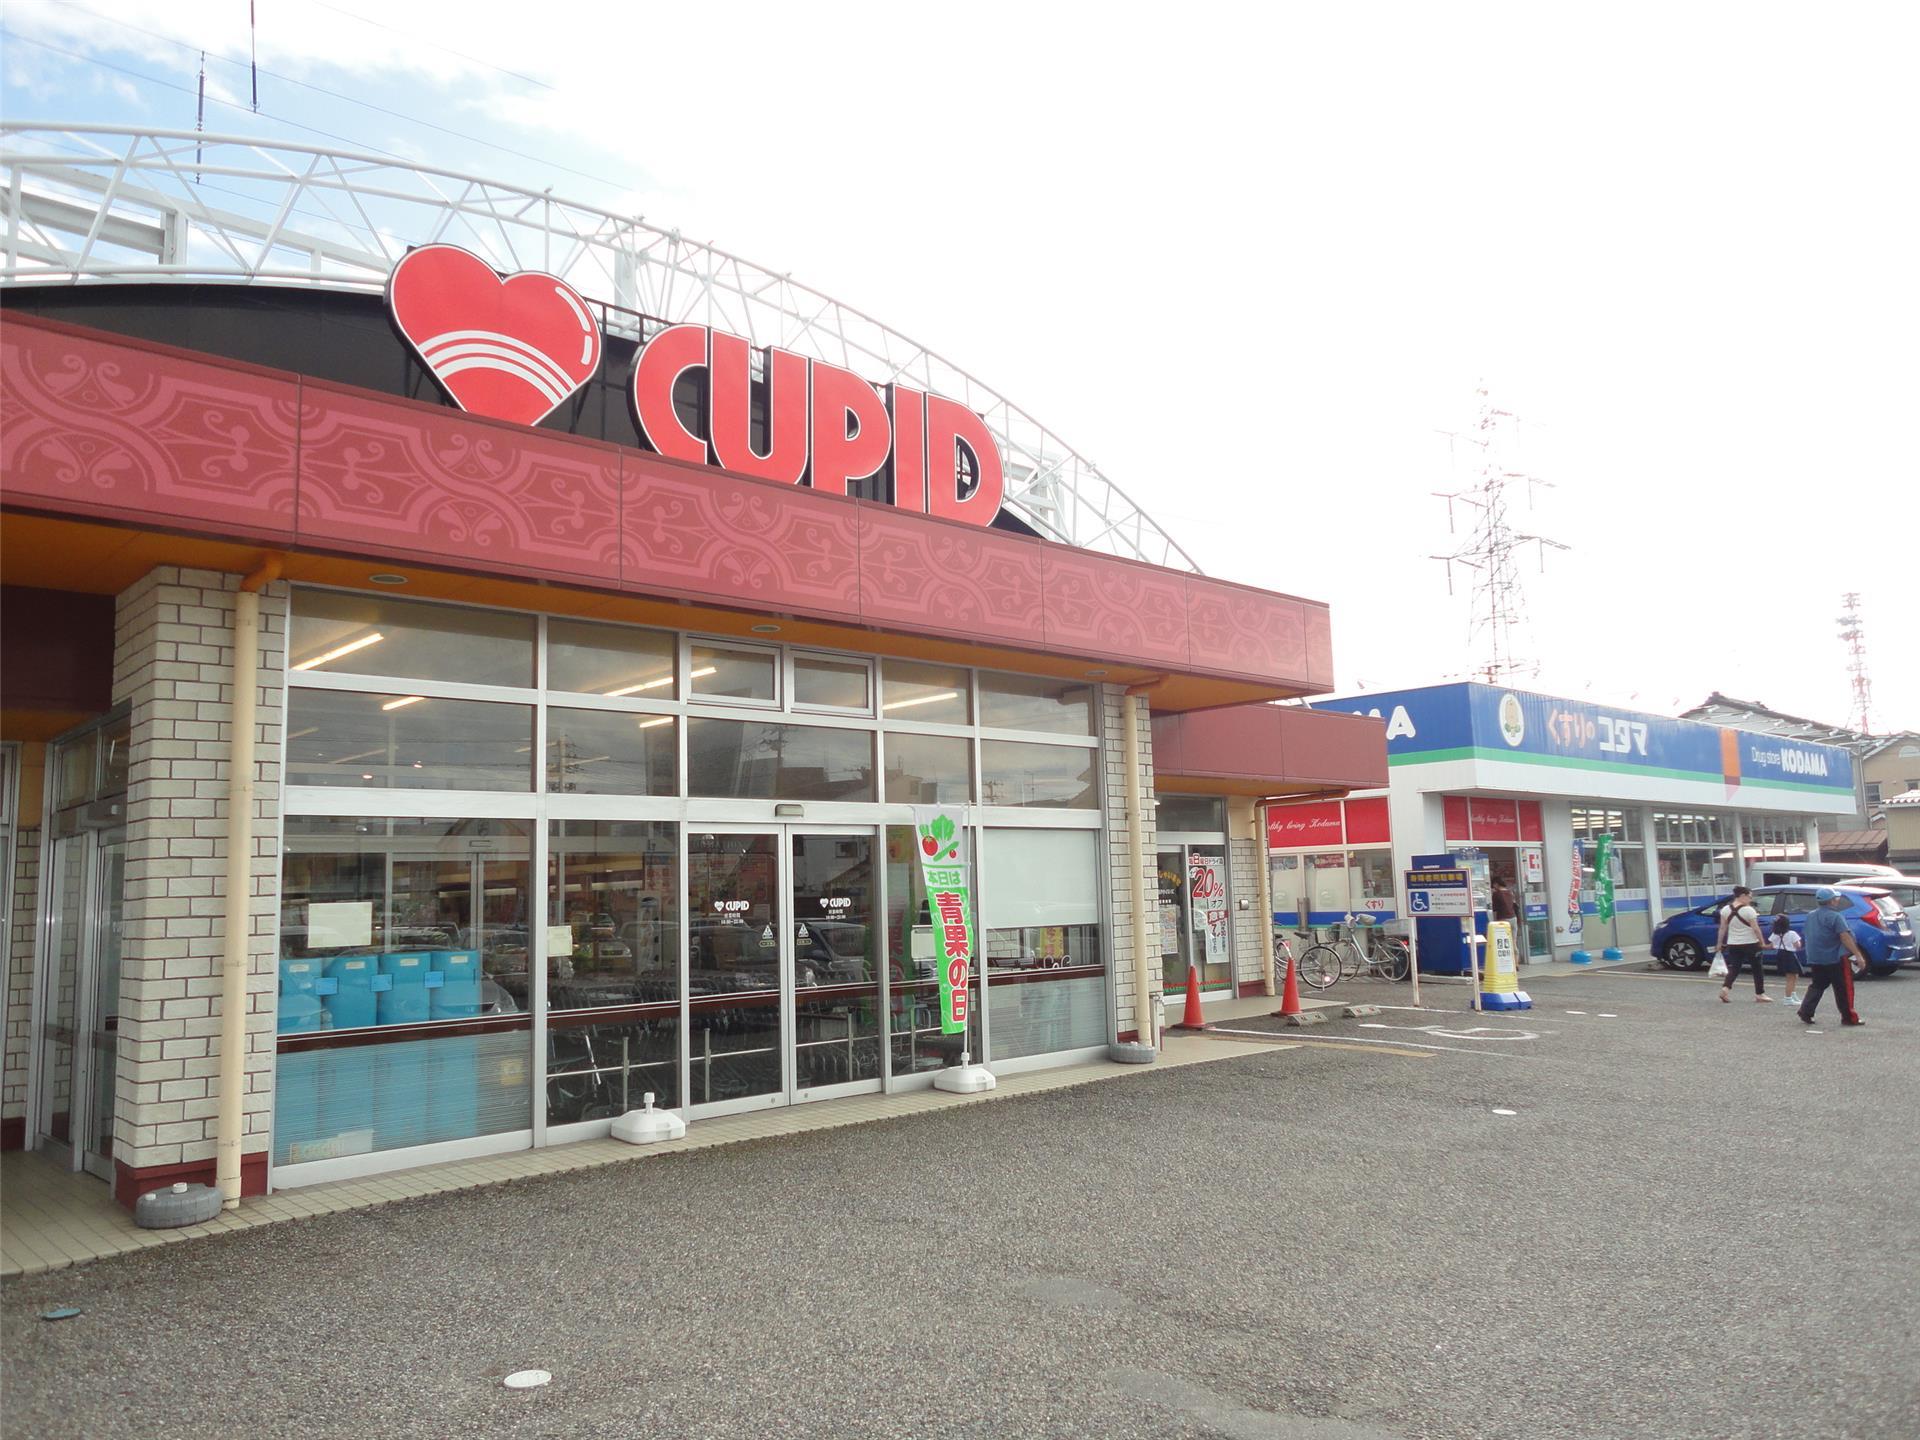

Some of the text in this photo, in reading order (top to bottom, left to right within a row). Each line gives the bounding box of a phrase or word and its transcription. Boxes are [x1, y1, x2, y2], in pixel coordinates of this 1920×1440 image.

[634, 323, 1004, 528] CUPID
[1751, 746, 1766, 767] Drug
[1781, 748, 1828, 776] KODAMA
[927, 871, 961, 885] 本日は
[1193, 868, 1224, 897] 20%
[725, 900, 750, 911] CUPID
[829, 897, 851, 908] CUPID
[935, 892, 970, 1022] 青果の日
